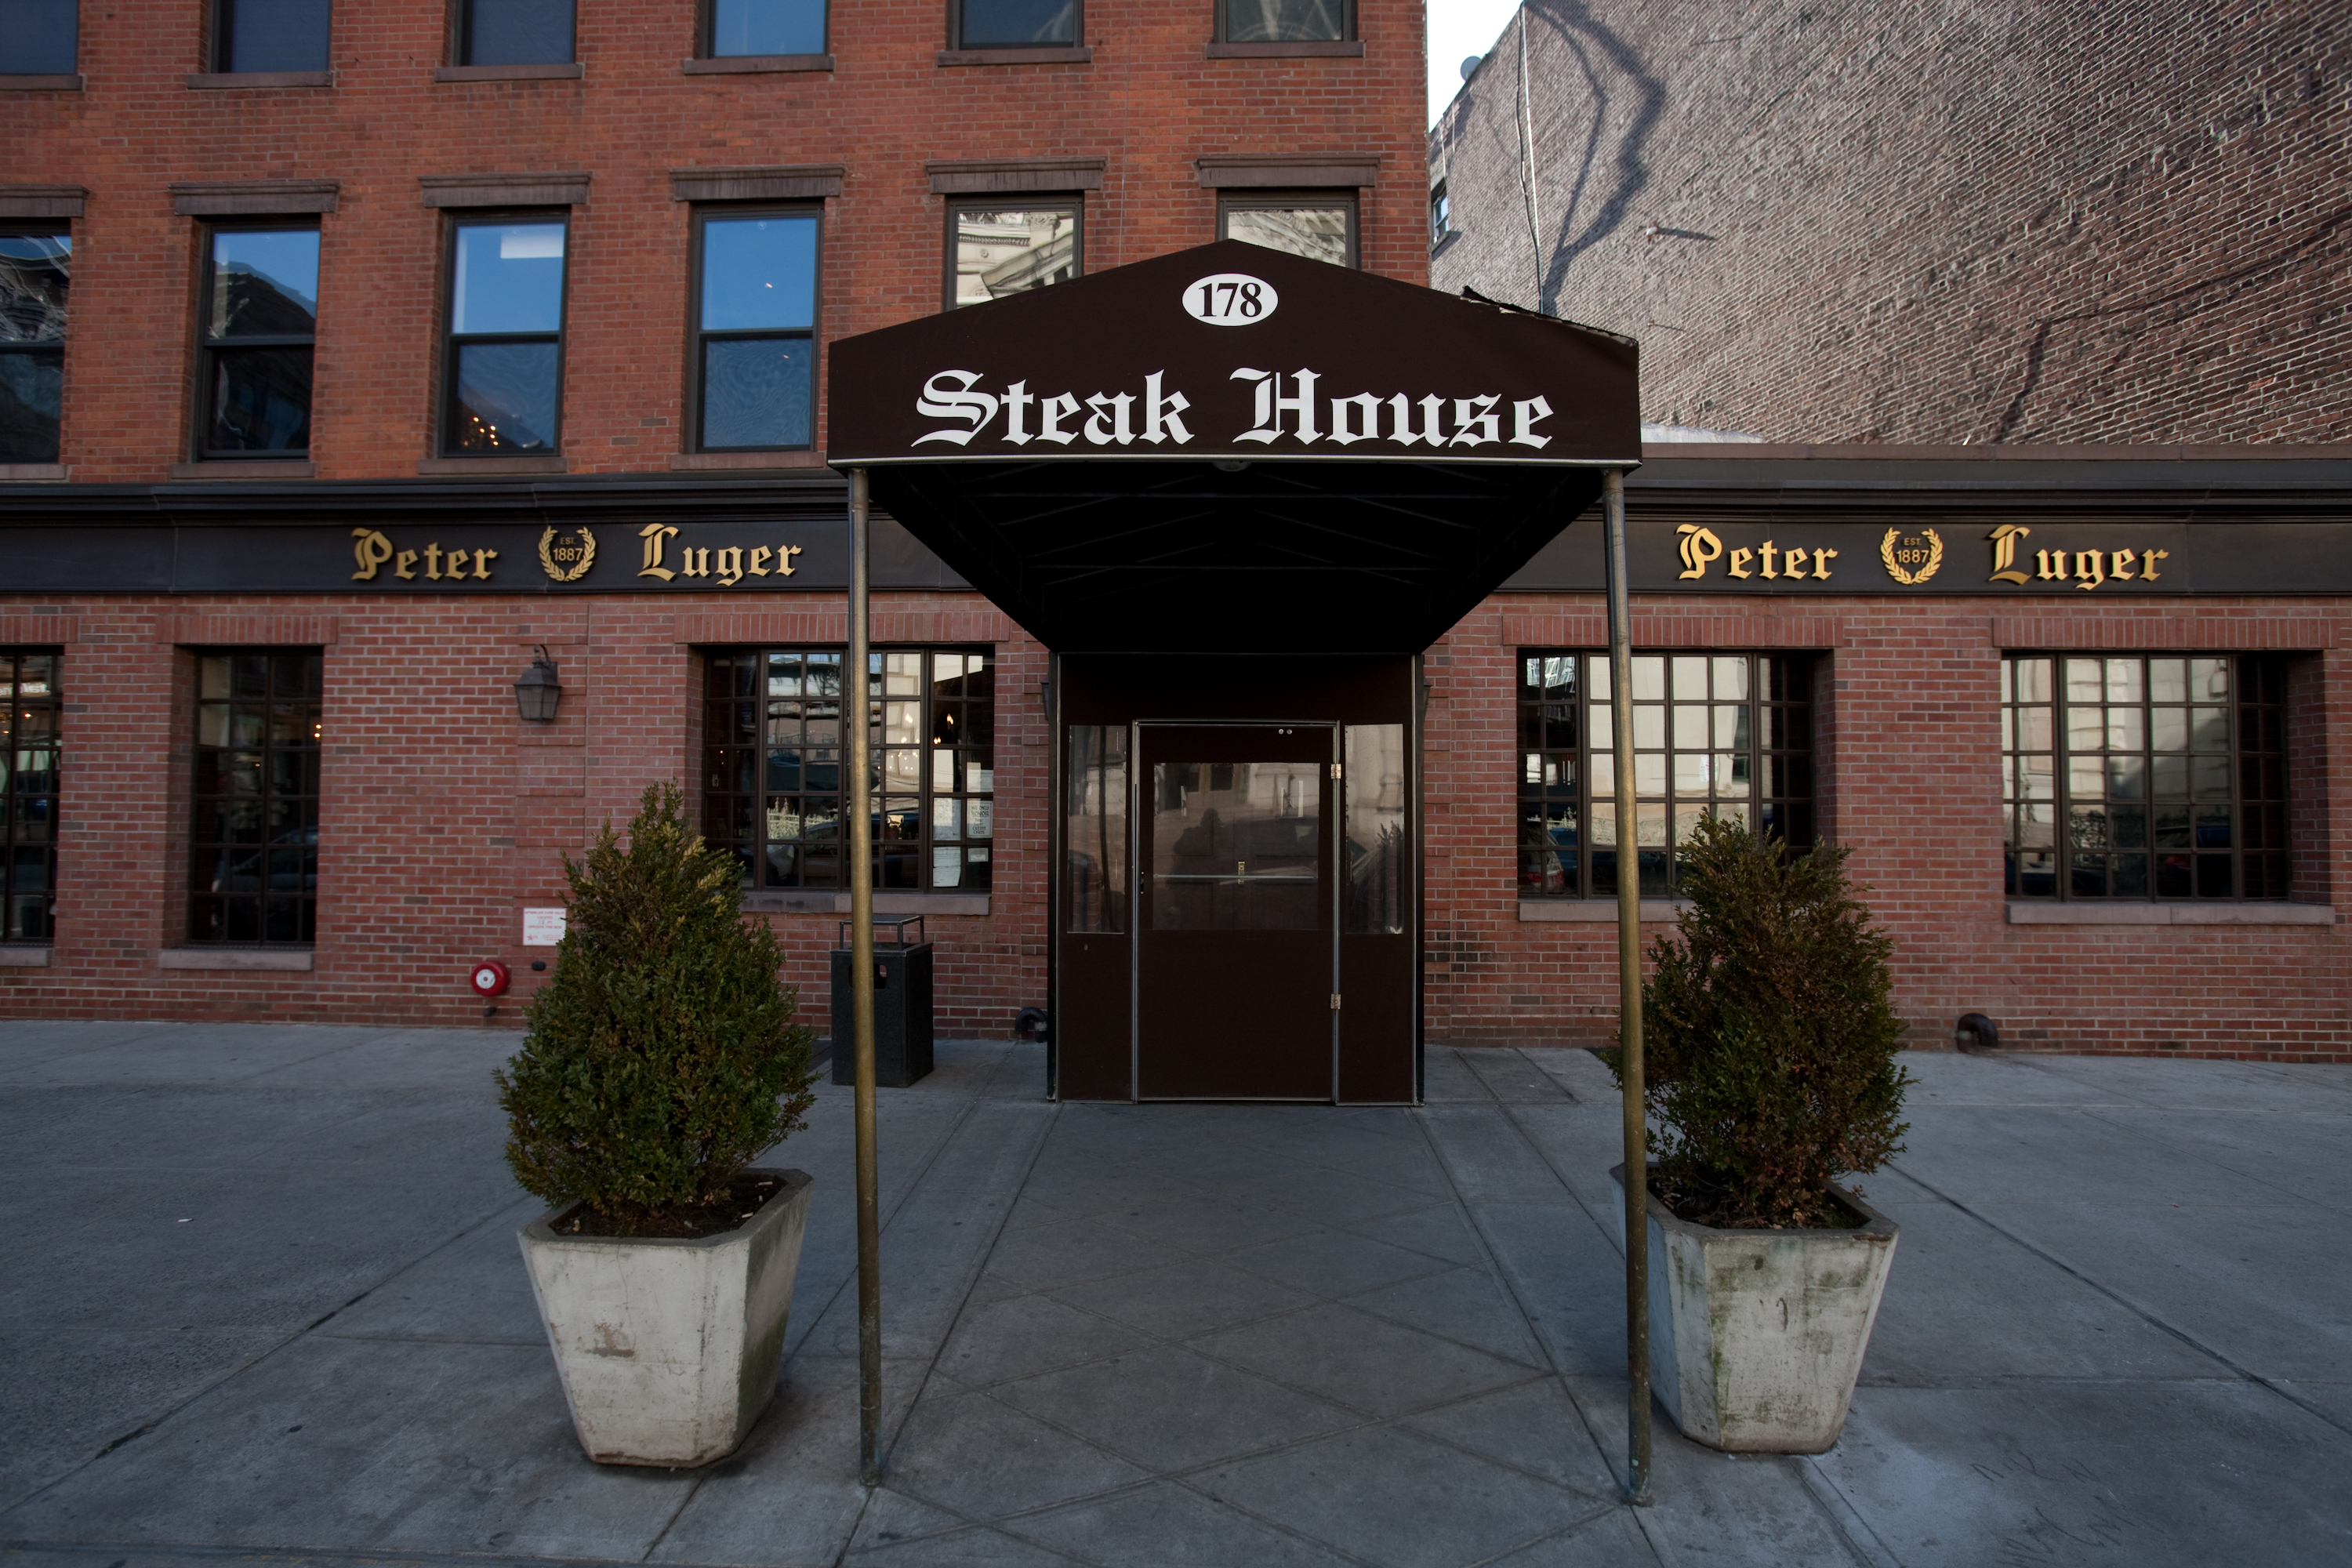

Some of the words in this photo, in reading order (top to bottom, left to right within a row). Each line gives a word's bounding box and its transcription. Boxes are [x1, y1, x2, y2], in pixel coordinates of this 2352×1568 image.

[1198, 282, 1262, 318] 178
[911, 369, 1195, 447] Steak
[1229, 368, 1554, 449] House
[350, 528, 498, 580] Peter
[553, 547, 583, 561] 1887
[637, 523, 802, 586] Luger
[1676, 523, 1838, 580] Peter
[1896, 550, 1929, 564] 1887
[1988, 524, 2169, 590] Luger
